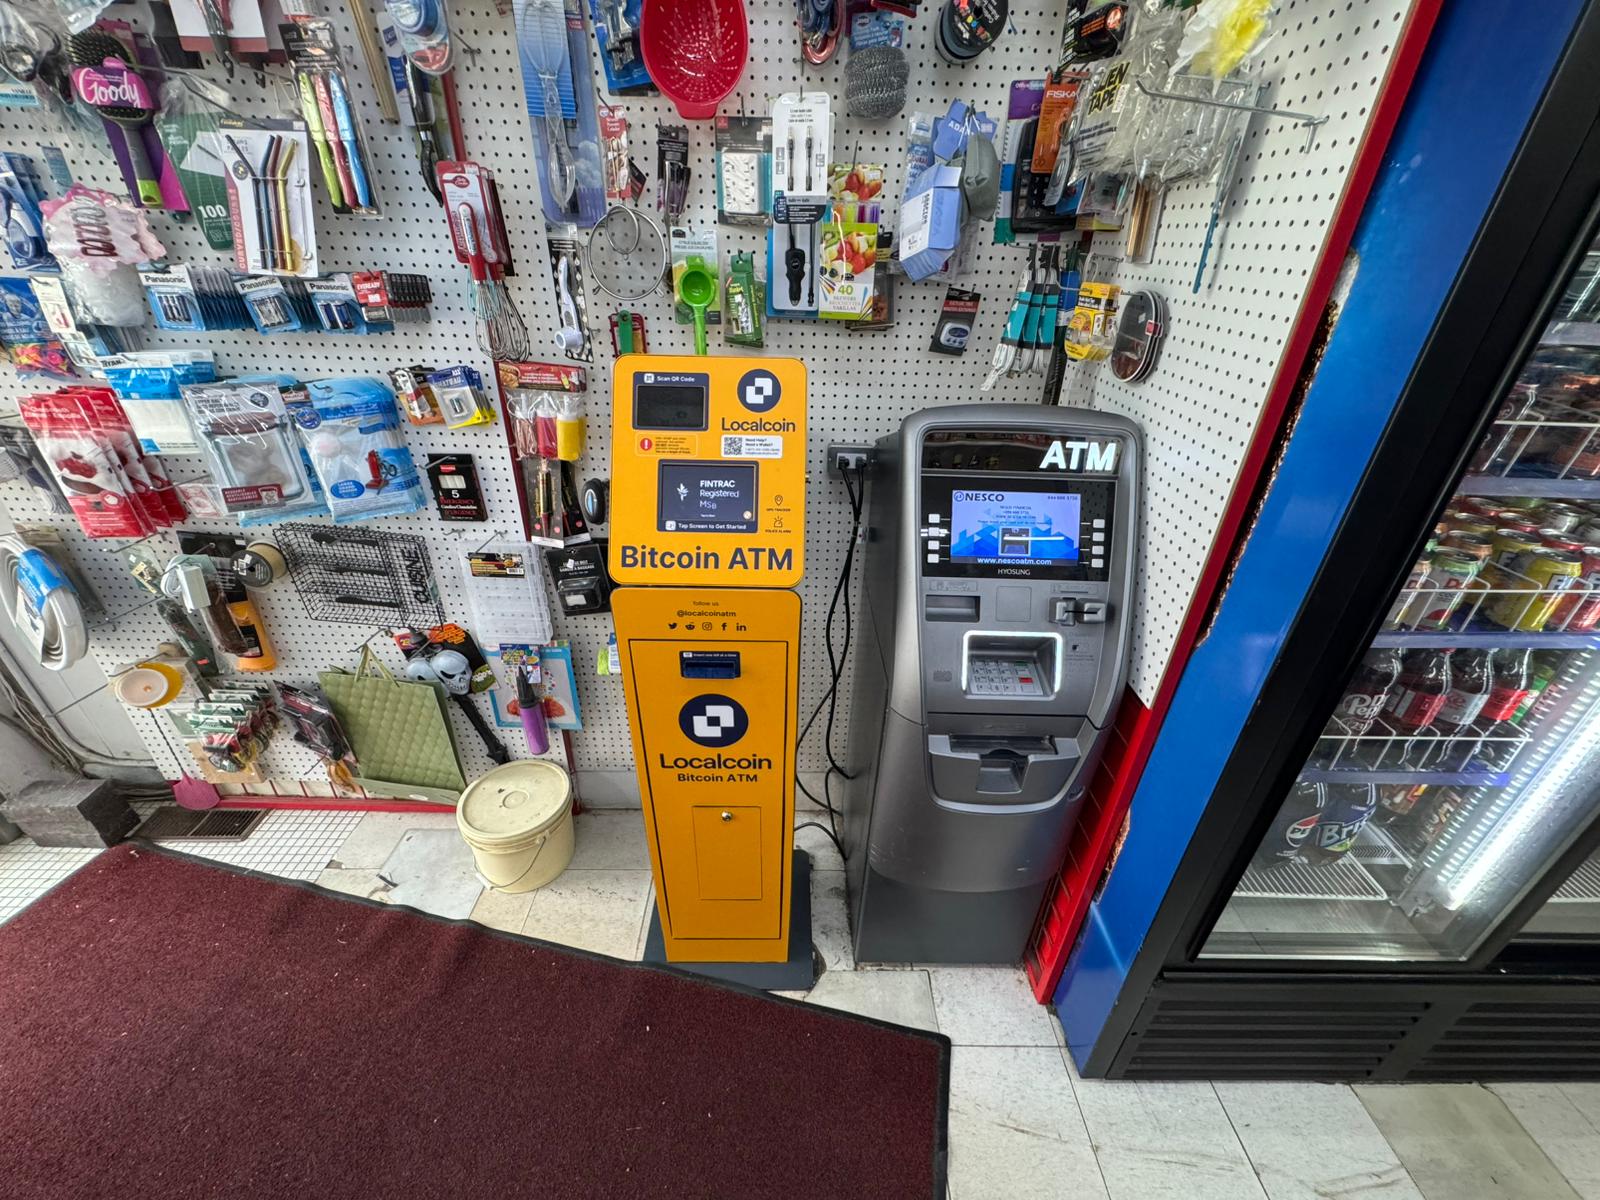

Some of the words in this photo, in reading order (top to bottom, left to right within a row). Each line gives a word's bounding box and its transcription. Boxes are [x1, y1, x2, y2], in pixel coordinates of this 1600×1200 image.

[79, 67, 140, 108] Goody
[1087, 85, 1117, 116] TAPE
[198, 204, 227, 218] 100
[143, 274, 187, 286] Panasonic
[239, 277, 278, 290] Panasonic
[309, 282, 350, 292] Panasonic
[838, 285, 854, 295] 40
[721, 417, 796, 433] Localcoin
[1039, 440, 1117, 471] ATM
[700, 480, 736, 488] FINTRAC
[452, 490, 460, 498] 5
[700, 490, 740, 499] Registered
[965, 493, 1004, 502] NESCO
[700, 500, 717, 510] MSB
[621, 545, 720, 570] Bitcoin
[728, 548, 792, 570] ATM
[978, 556, 1052, 565] www.nescoatm.com
[660, 753, 772, 770] Localcoin
[678, 773, 724, 782] Bitcoin
[726, 774, 758, 782] ATM
